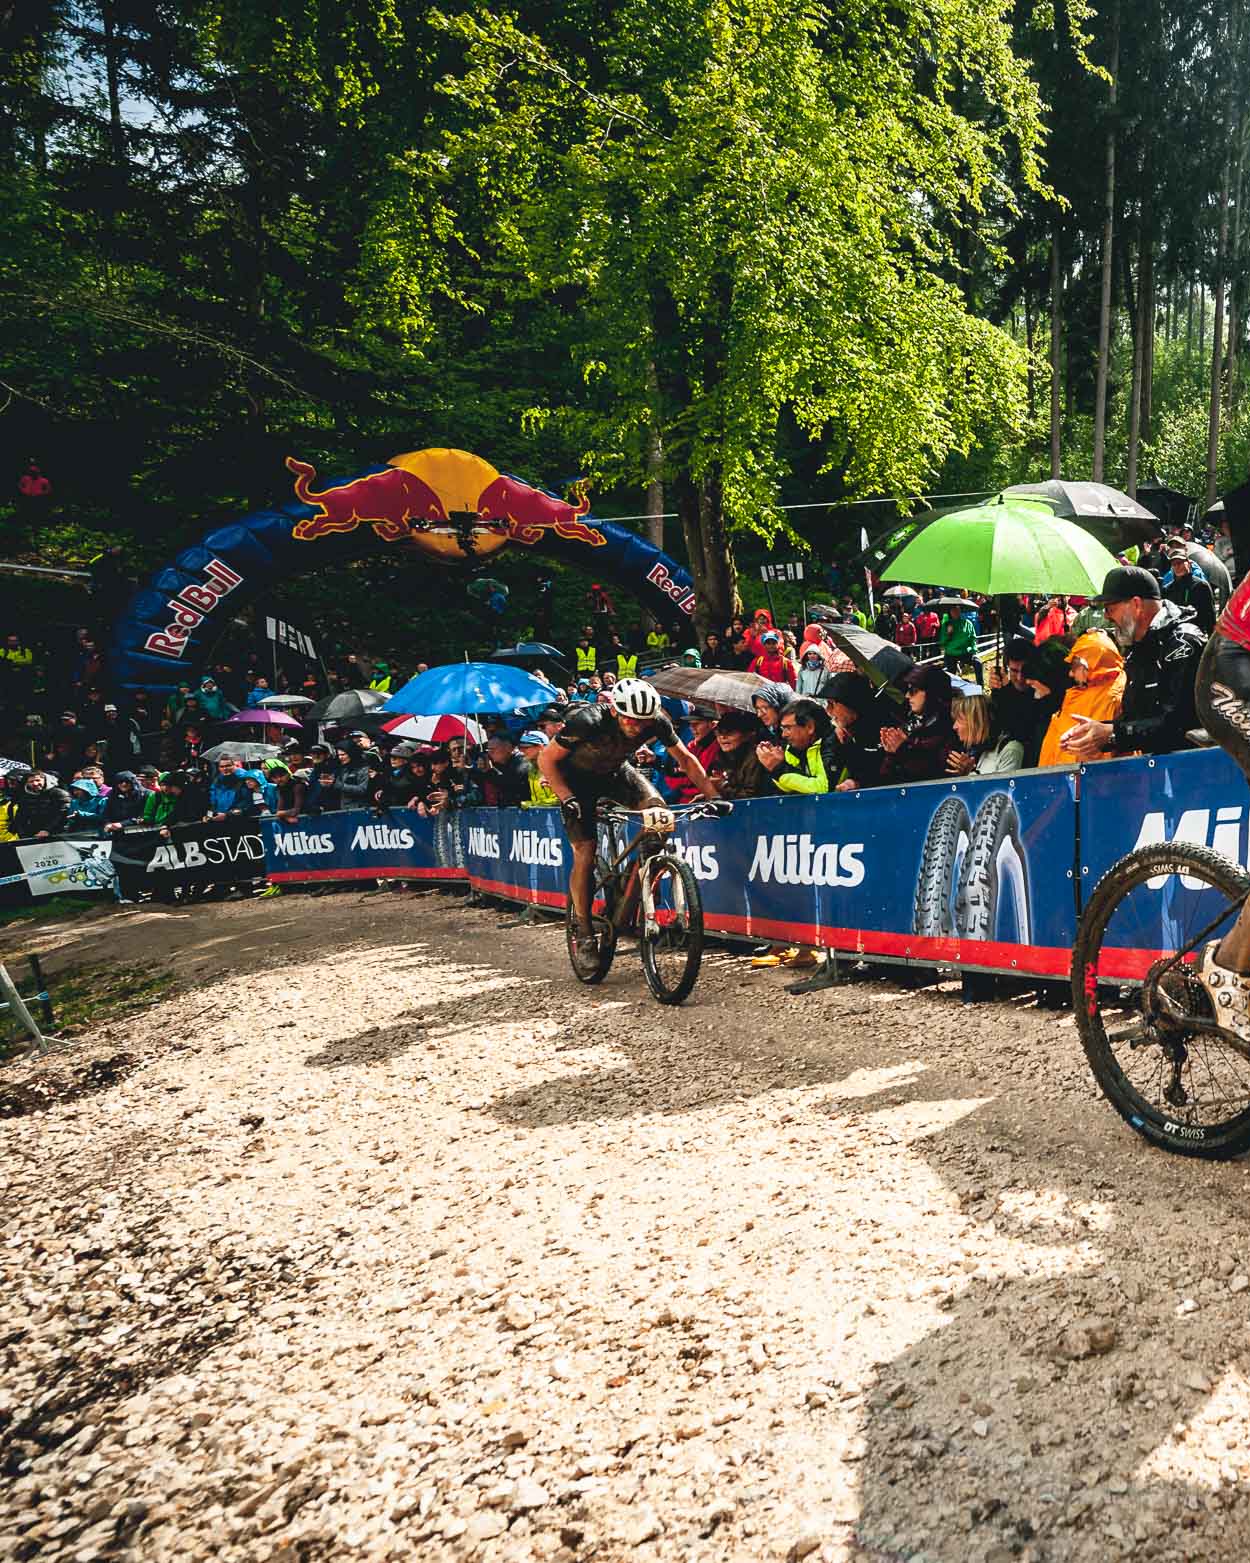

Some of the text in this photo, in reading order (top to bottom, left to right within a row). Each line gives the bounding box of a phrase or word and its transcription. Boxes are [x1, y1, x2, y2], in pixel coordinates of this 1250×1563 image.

[646, 562, 690, 602] Red
[144, 558, 244, 659] Red Bull
[648, 811, 669, 825] 15
[146, 833, 264, 872] ALBSTAD
[274, 831, 335, 857] Mitas
[350, 825, 415, 851] Mitas
[509, 829, 563, 867] Mitas
[34, 859, 59, 868] 2020
[659, 837, 719, 881] tas
[748, 833, 865, 887] Mitas
[1163, 1121, 1206, 1140] DT SWISS
